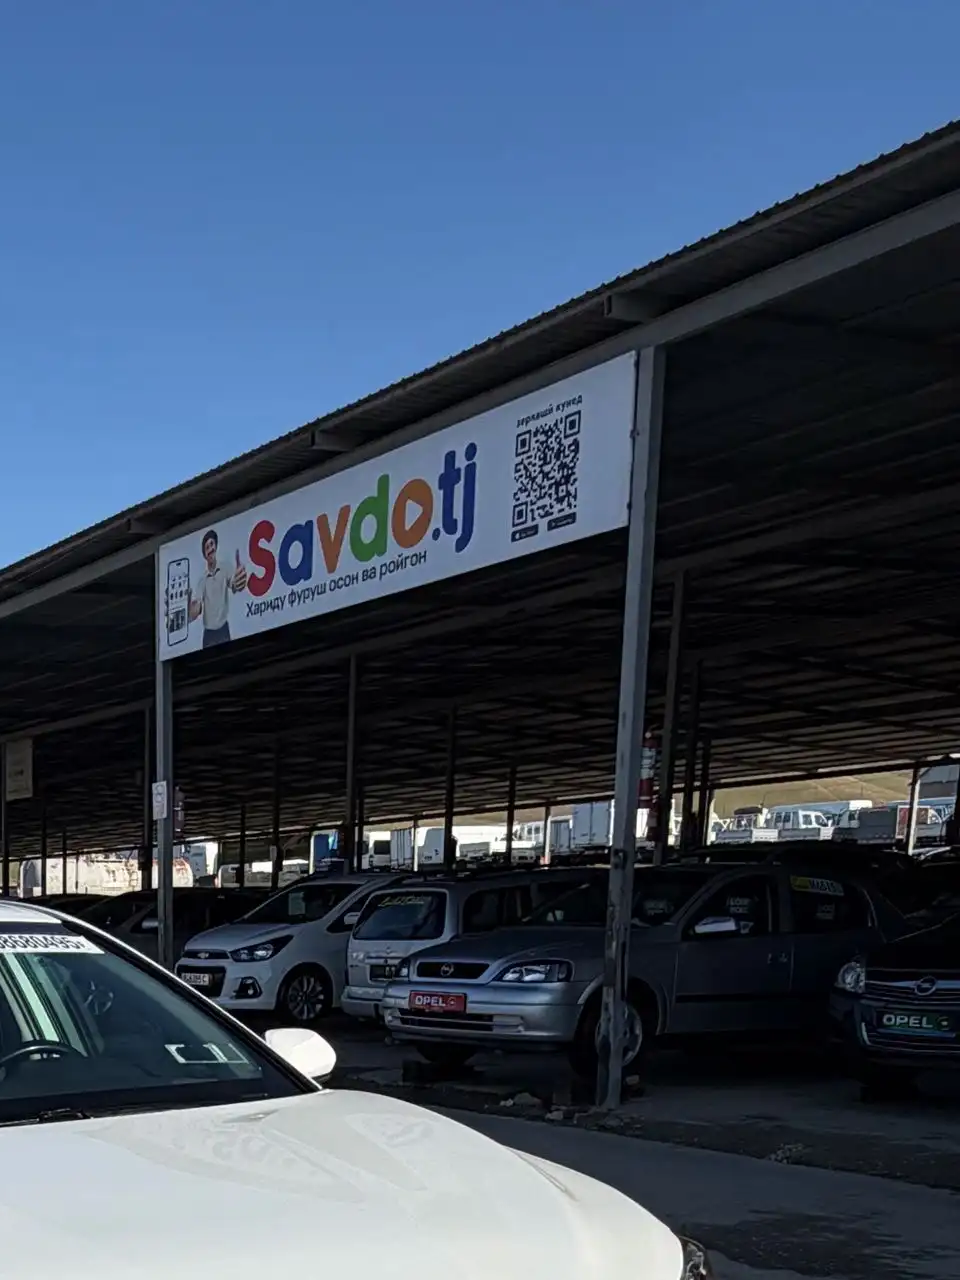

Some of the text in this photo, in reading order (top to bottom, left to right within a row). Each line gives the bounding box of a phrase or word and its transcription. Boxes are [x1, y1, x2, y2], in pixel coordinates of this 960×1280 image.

[246, 550, 428, 617] Хариду фуруш осон ва ройгон
[415, 995, 446, 1007] OPEL
[882, 1013, 934, 1028] OPEL
